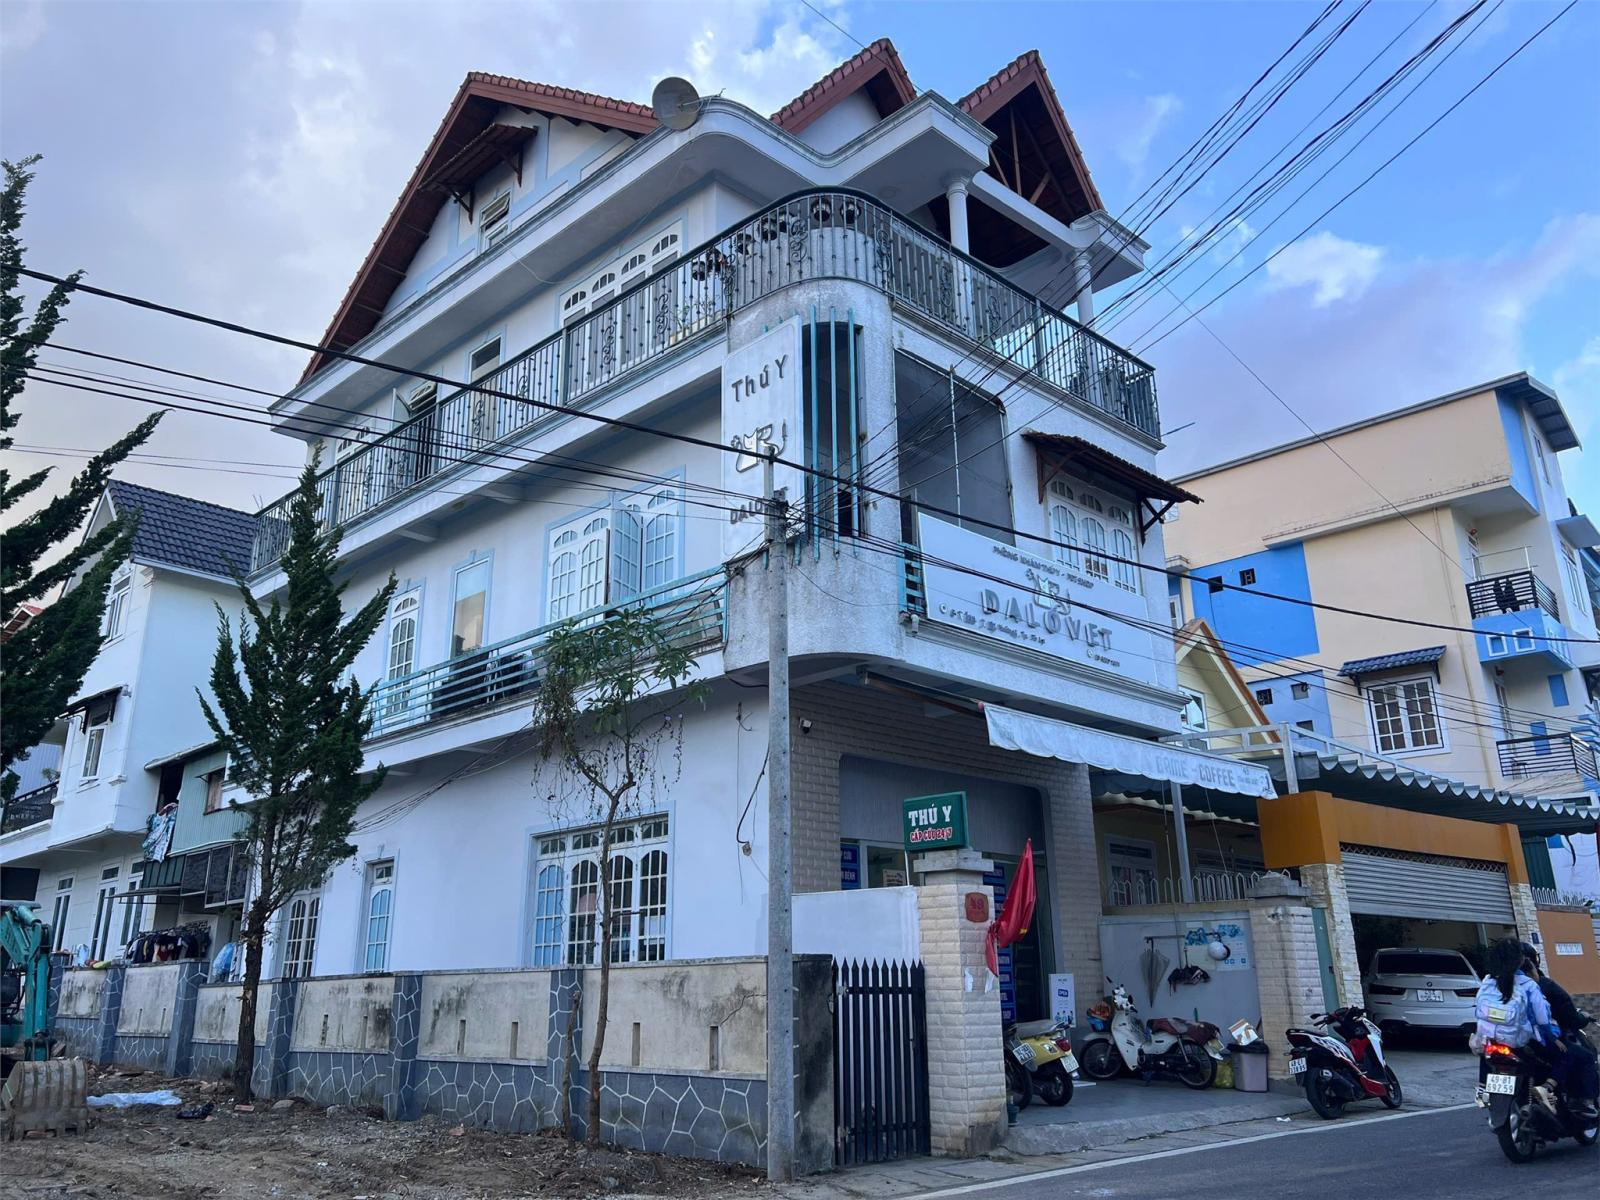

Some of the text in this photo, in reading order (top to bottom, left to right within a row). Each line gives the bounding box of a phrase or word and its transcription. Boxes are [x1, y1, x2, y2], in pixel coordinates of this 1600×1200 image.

[731, 354, 788, 402] Thú Y
[1199, 763, 1236, 788] COFFEE
[908, 803, 952, 827] THÚ Y
